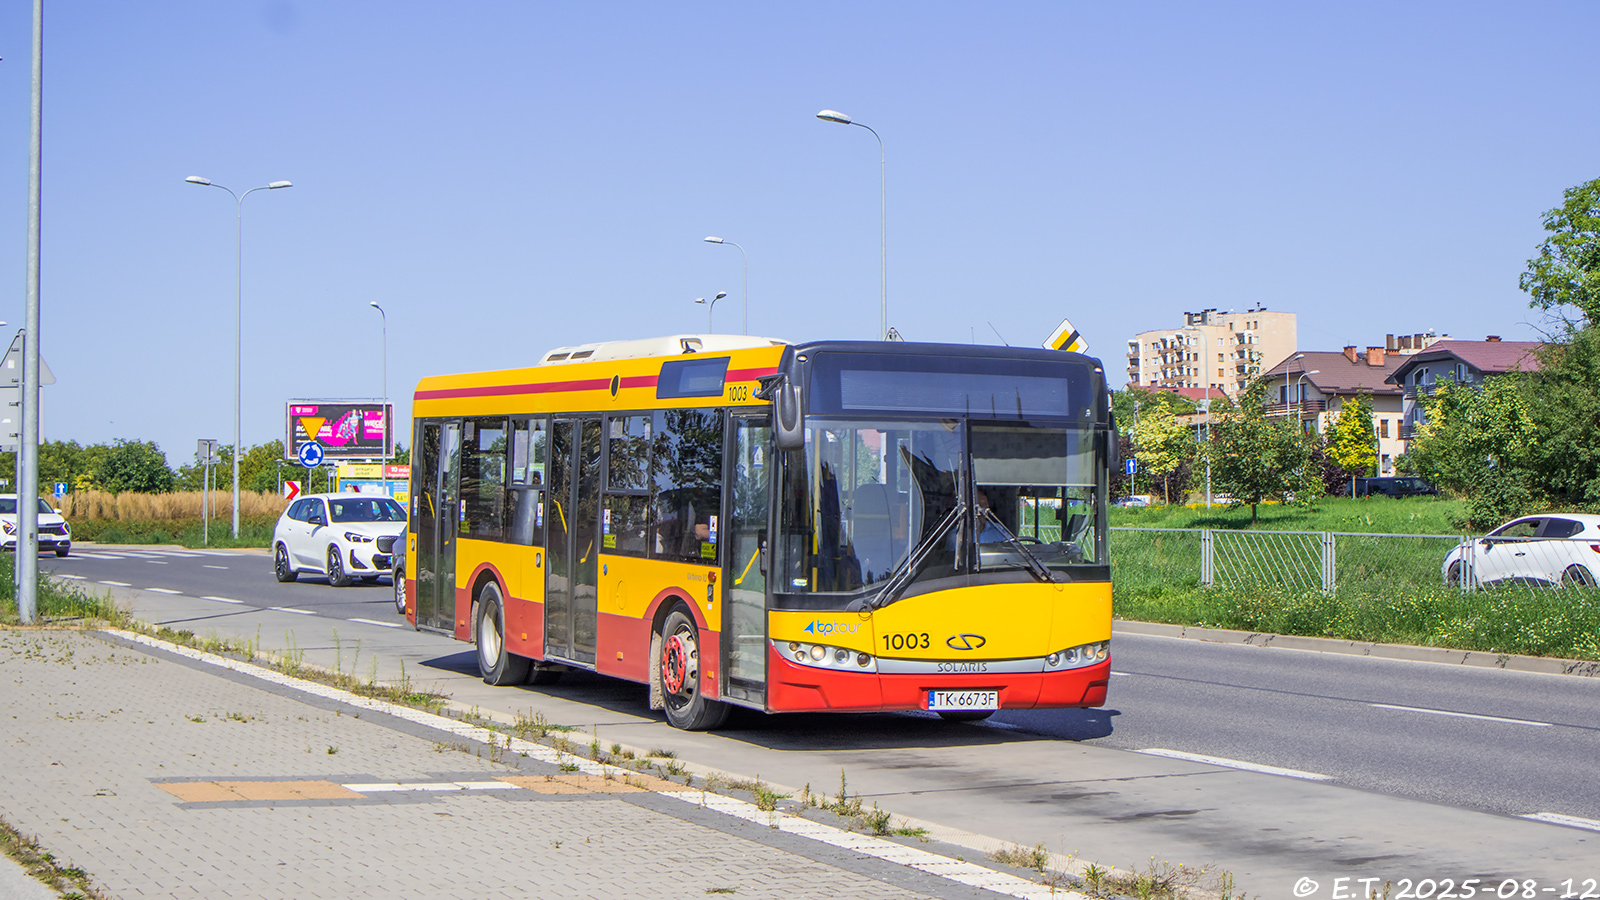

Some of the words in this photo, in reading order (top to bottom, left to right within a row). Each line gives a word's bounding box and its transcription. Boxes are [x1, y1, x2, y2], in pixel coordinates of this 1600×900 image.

[729, 385, 747, 401] 1003
[816, 620, 861, 637] bptour
[882, 633, 930, 650] 1003
[937, 662, 988, 673] SOLARIS
[937, 692, 954, 706] TK
[958, 692, 996, 706] 6673F
